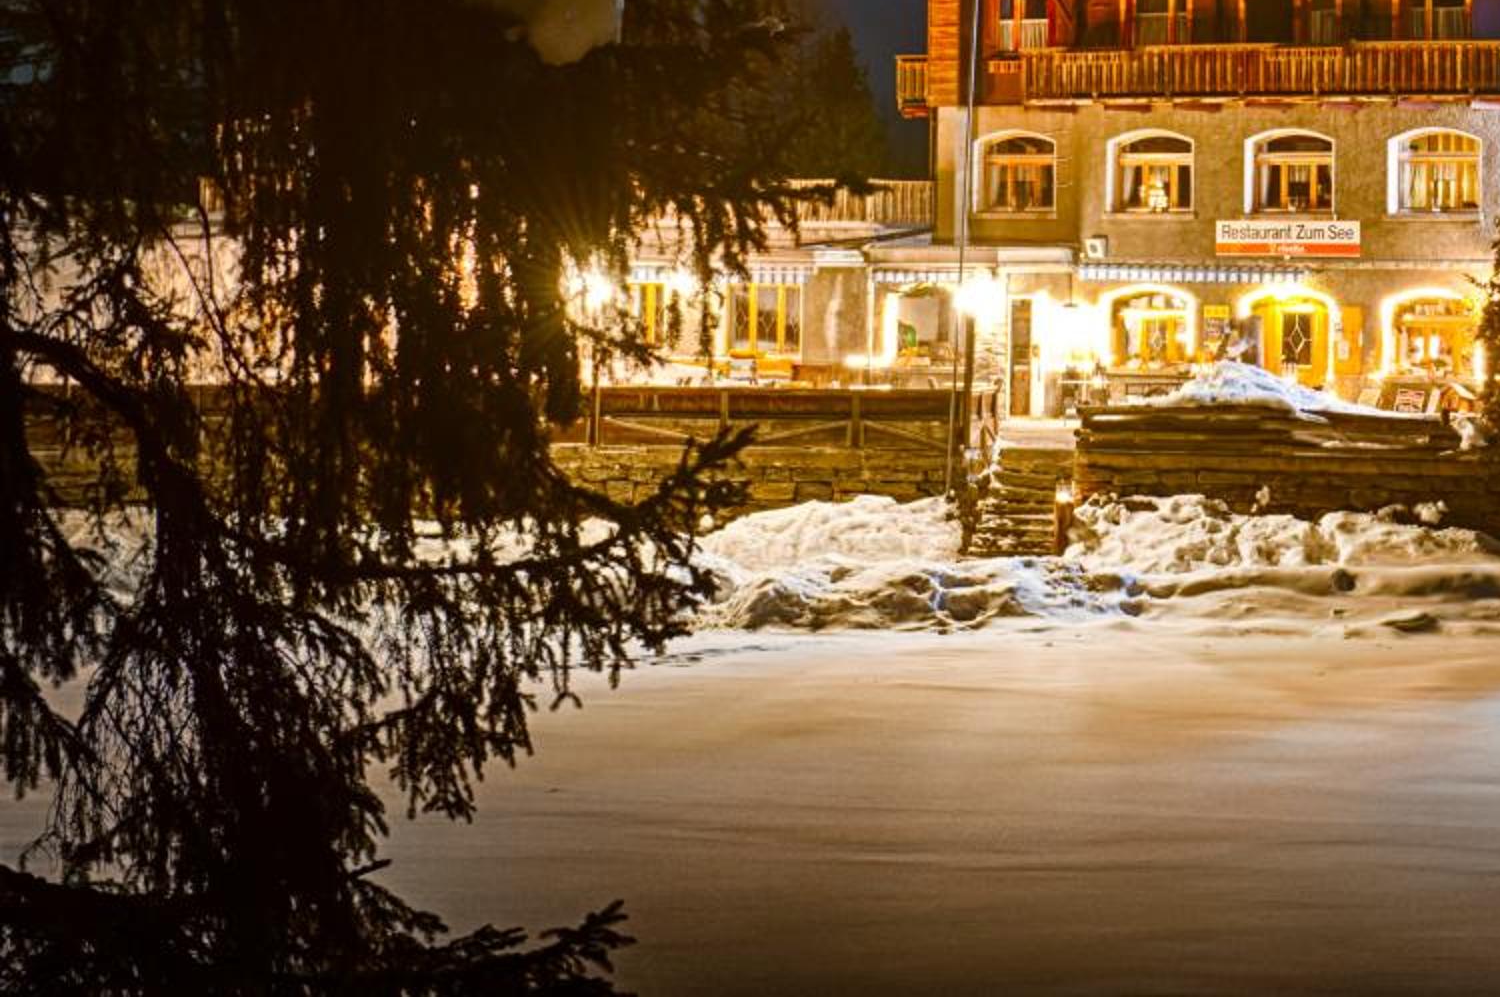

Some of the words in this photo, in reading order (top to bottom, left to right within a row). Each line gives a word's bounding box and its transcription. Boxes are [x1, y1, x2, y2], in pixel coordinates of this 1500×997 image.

[1221, 224, 1291, 240] Restaurant
[1296, 225, 1325, 240] Zum
[1328, 225, 1355, 240] See
